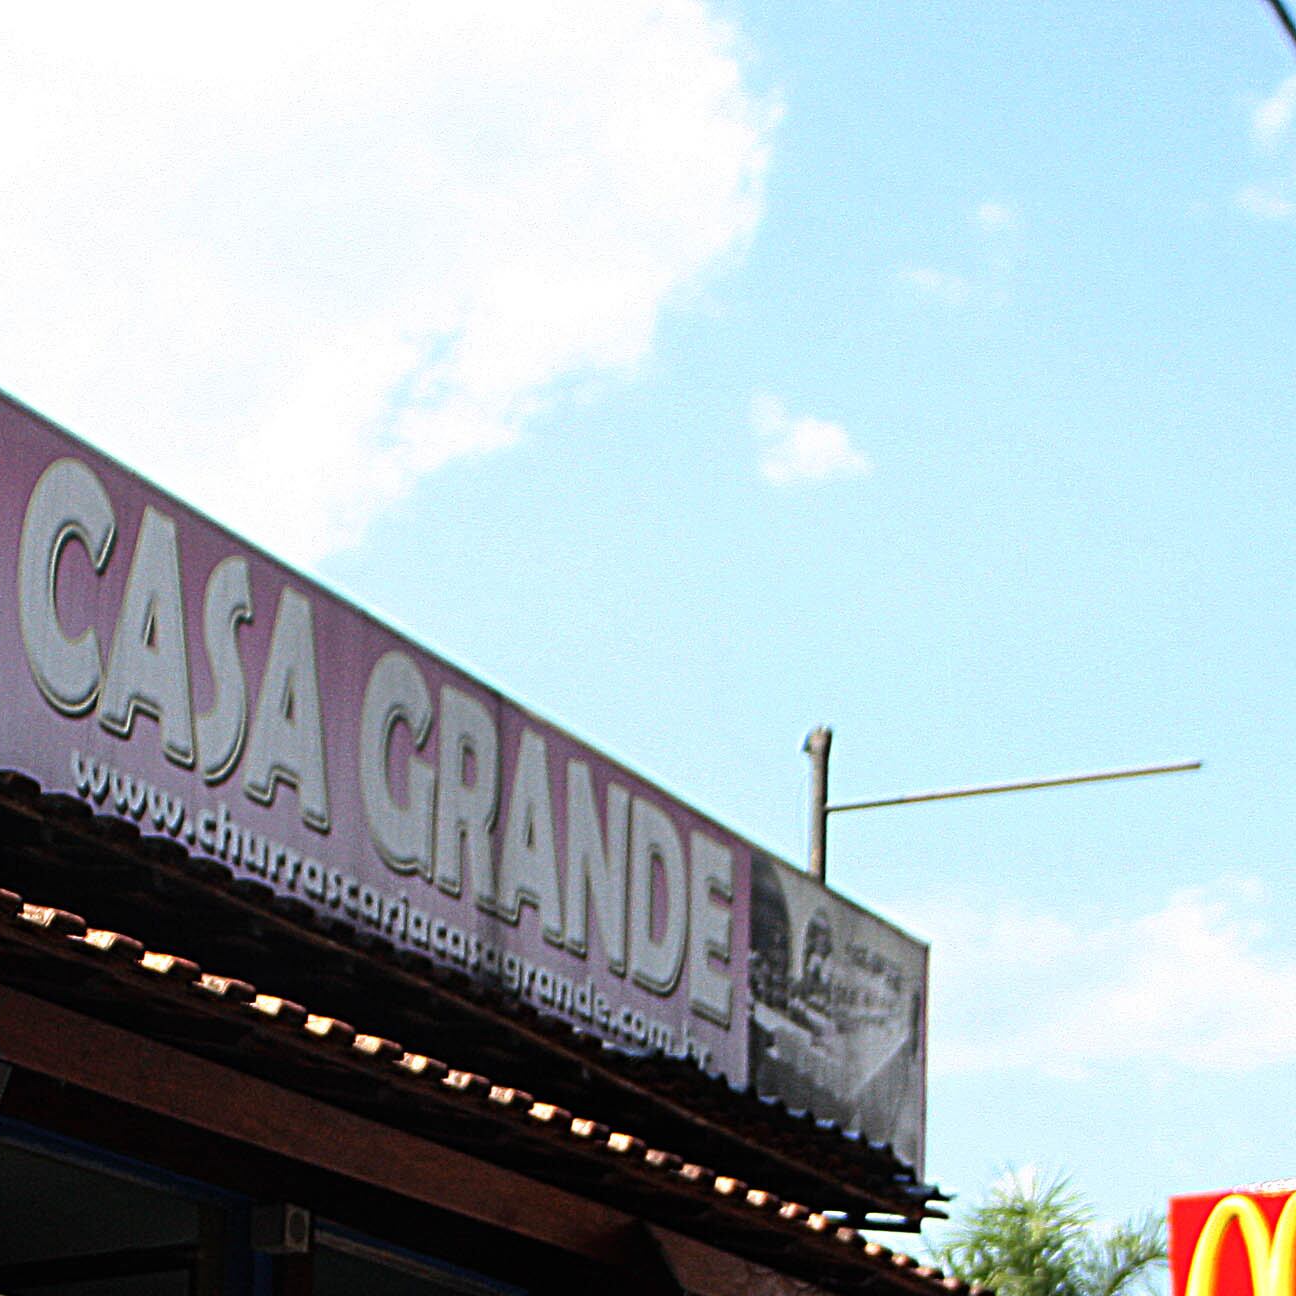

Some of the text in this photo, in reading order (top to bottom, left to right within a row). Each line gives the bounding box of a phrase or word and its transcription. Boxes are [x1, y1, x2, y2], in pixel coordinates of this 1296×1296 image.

[17, 458, 330, 832] CASA
[360, 650, 734, 1031] GRANDE
[71, 750, 712, 1072] www.churrascariacasagrande.combr
